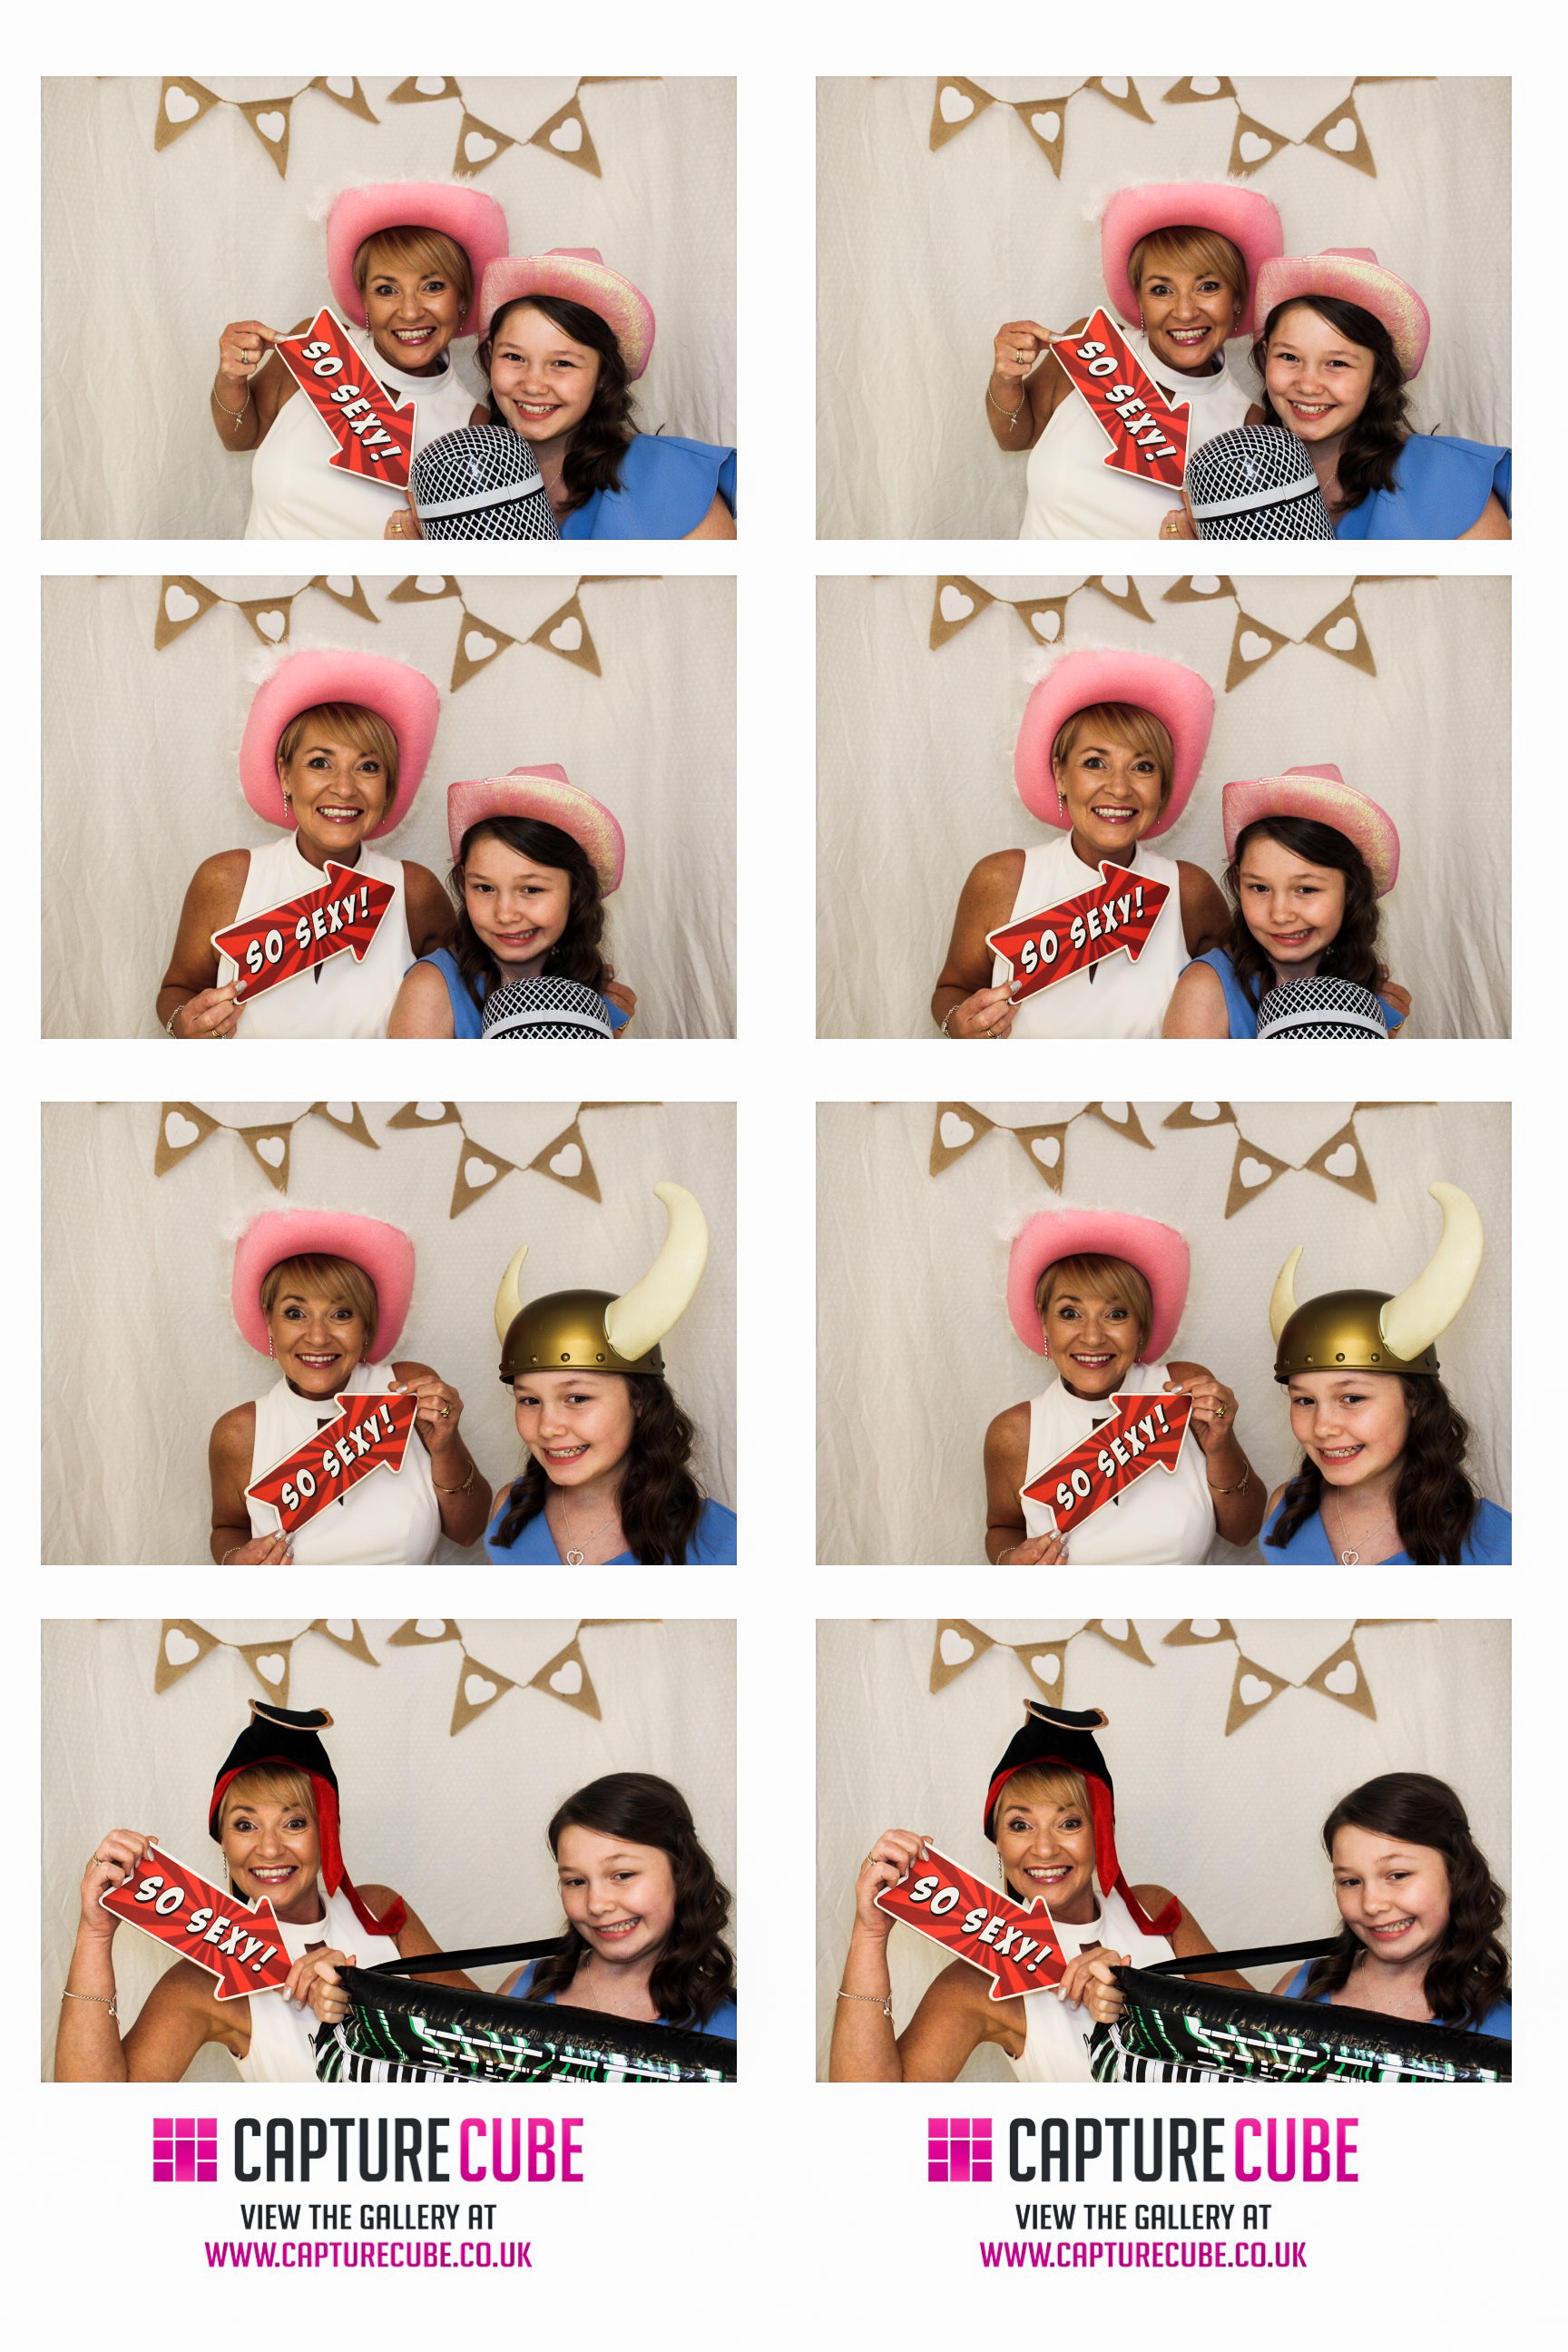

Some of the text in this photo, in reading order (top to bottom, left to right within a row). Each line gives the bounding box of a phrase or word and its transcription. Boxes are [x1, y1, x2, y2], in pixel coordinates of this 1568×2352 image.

[301, 341, 402, 463] SO SEXY!
[1076, 341, 1177, 463] SO SEXY!
[246, 886, 369, 975] SO SEXY!
[1021, 886, 1144, 975] SO SEXY!
[281, 1403, 396, 1511] SO SEXY!
[1056, 1403, 1171, 1511] SO SEXY!
[133, 1876, 278, 1973] SO SEXY!
[908, 1876, 1053, 1973] SO SEXY!
